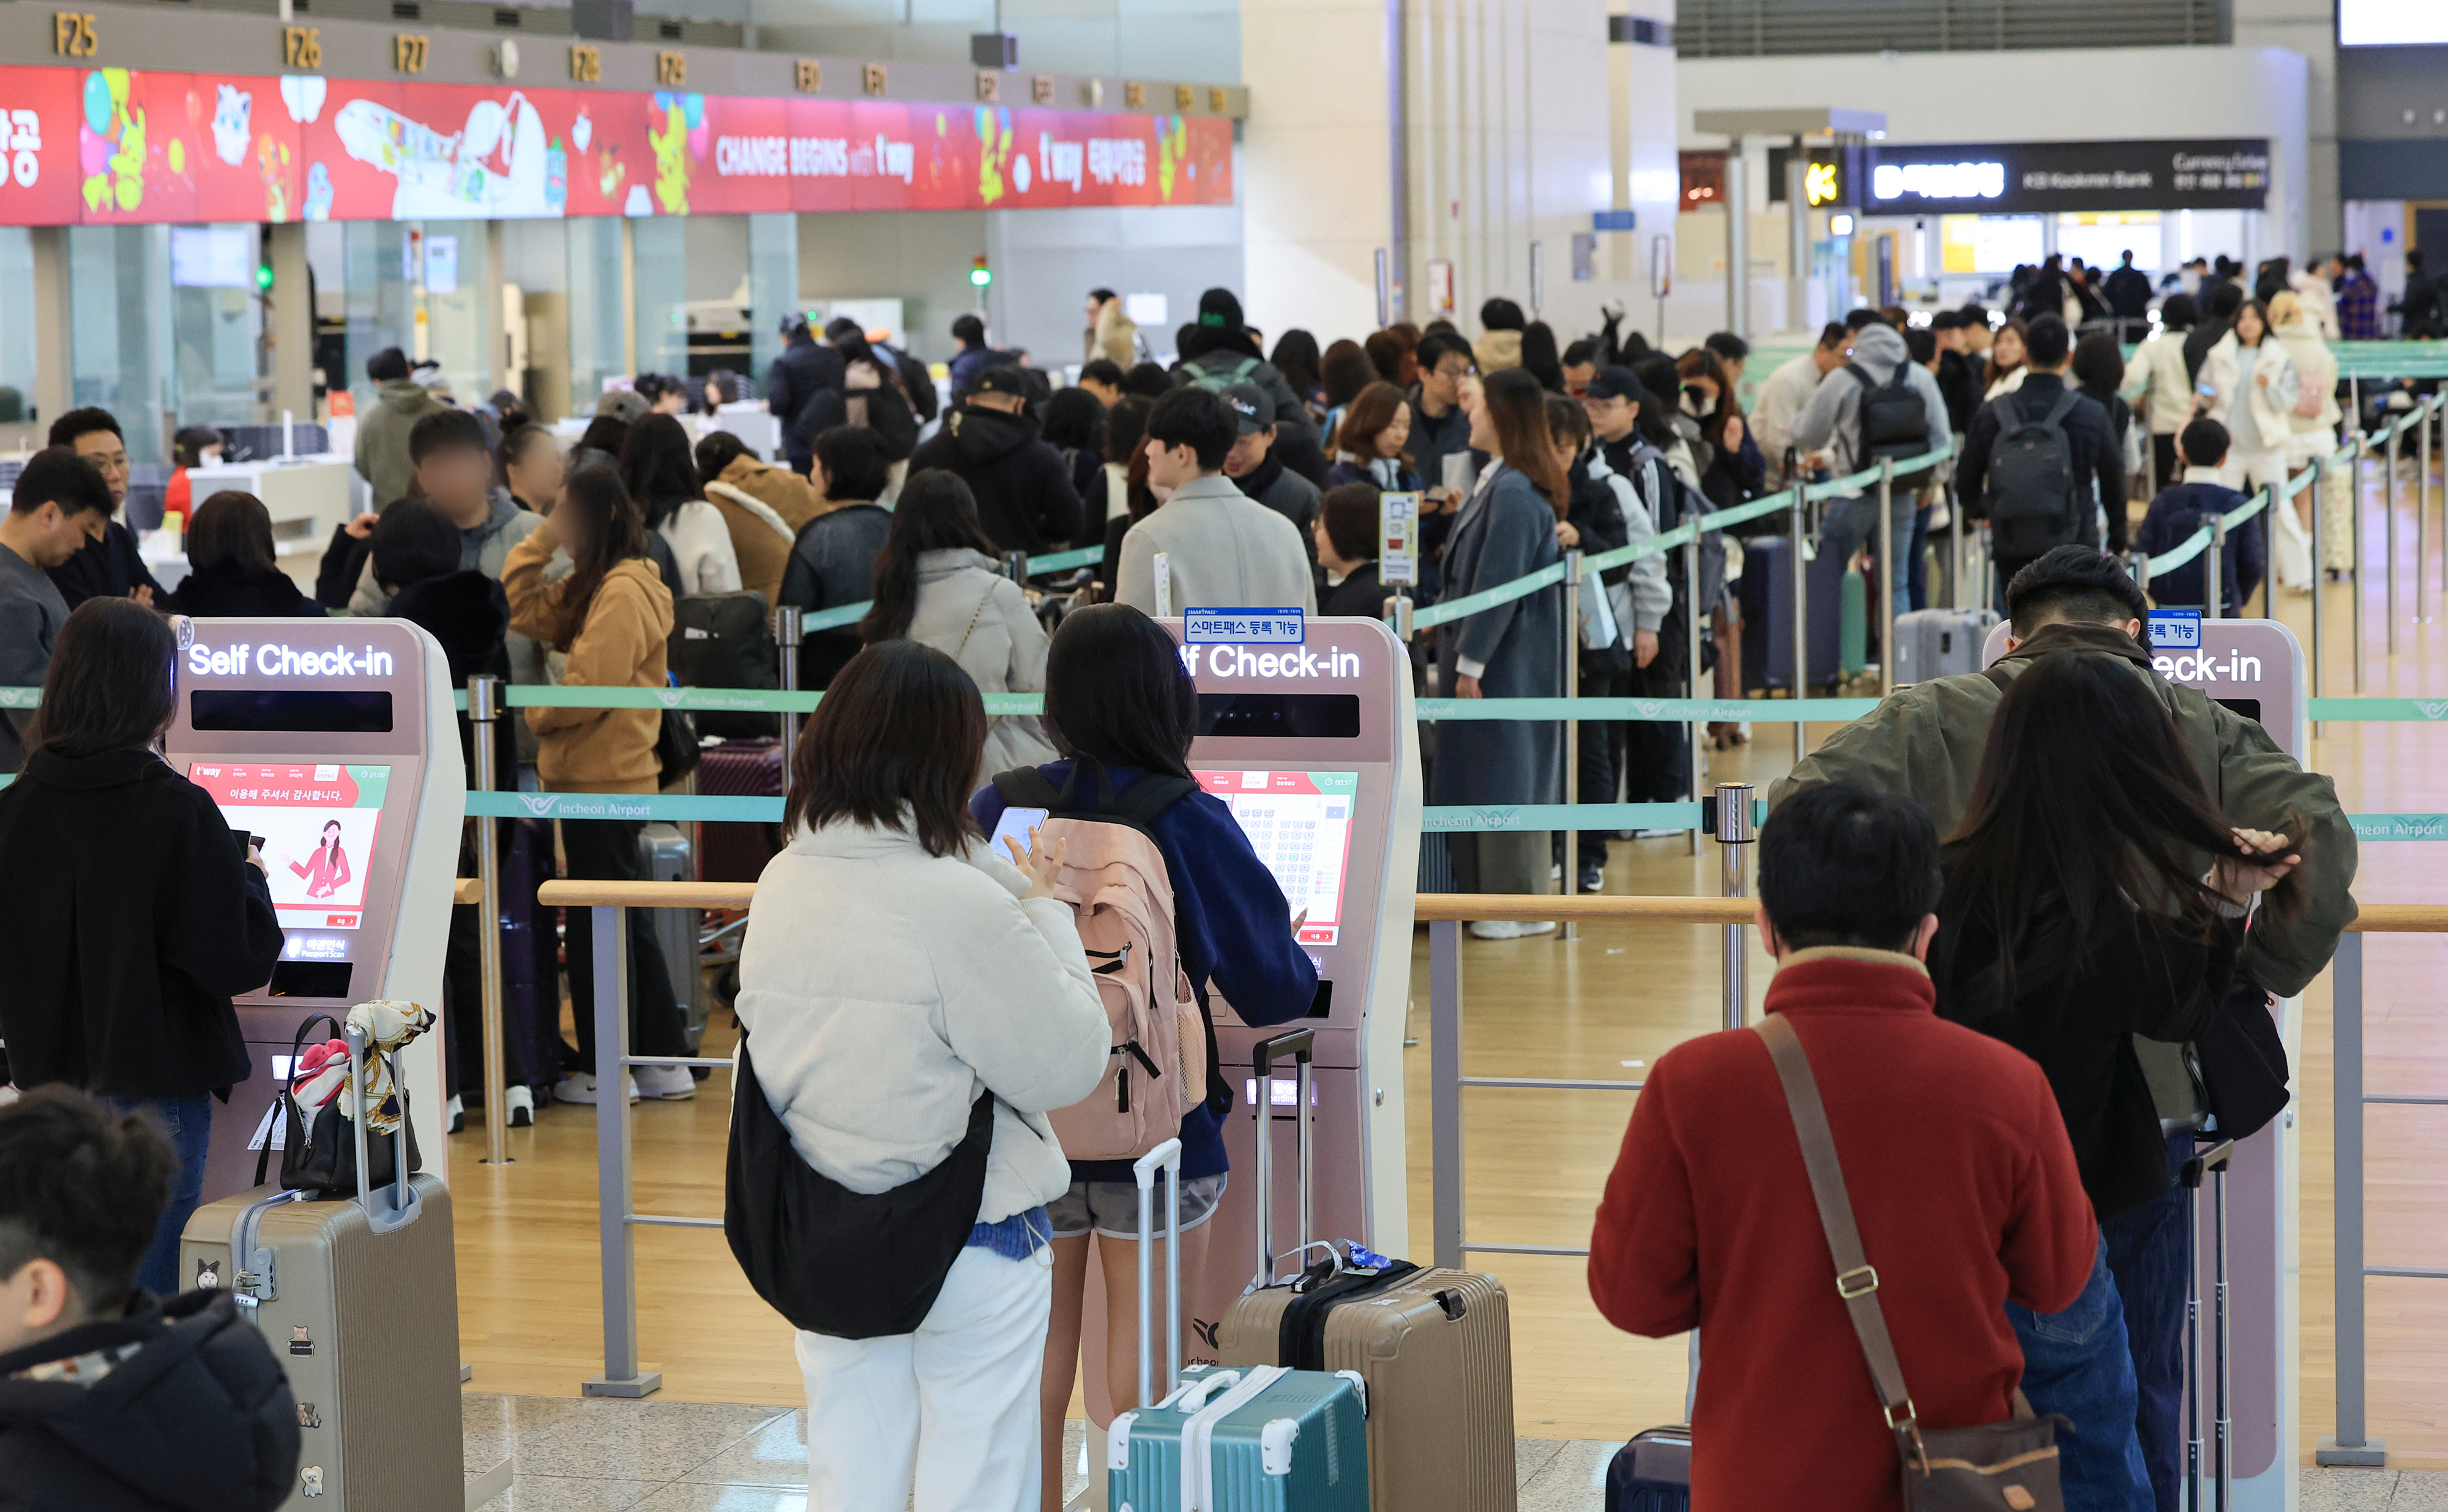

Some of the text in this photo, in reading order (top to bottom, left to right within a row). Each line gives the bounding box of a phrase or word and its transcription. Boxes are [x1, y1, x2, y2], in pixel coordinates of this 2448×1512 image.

[56, 12, 98, 56] F25
[285, 26, 322, 69] F26
[396, 34, 428, 73] F27
[716, 135, 787, 176] CHANGE
[789, 136, 848, 176] BEGINS
[1191, 621, 1298, 635] 스마트패스 등록 가능
[2170, 624, 2195, 639] 가능
[188, 644, 393, 676] Self Check-in
[1179, 645, 1360, 677] lf Check-in
[2152, 649, 2262, 682] eck-in
[196, 766, 222, 778] t'way
[230, 789, 342, 801] 이용해 주셔서 감사합니다.
[559, 803, 651, 817] Incheon Airport
[1423, 814, 1521, 827] ncheon Airport
[2394, 824, 2444, 837] Airport
[307, 939, 346, 951] 여권인식
[301, 950, 329, 958] Passport
[1274, 1082, 1297, 1095] 탑승
[1188, 1356, 1218, 1366] cheo
